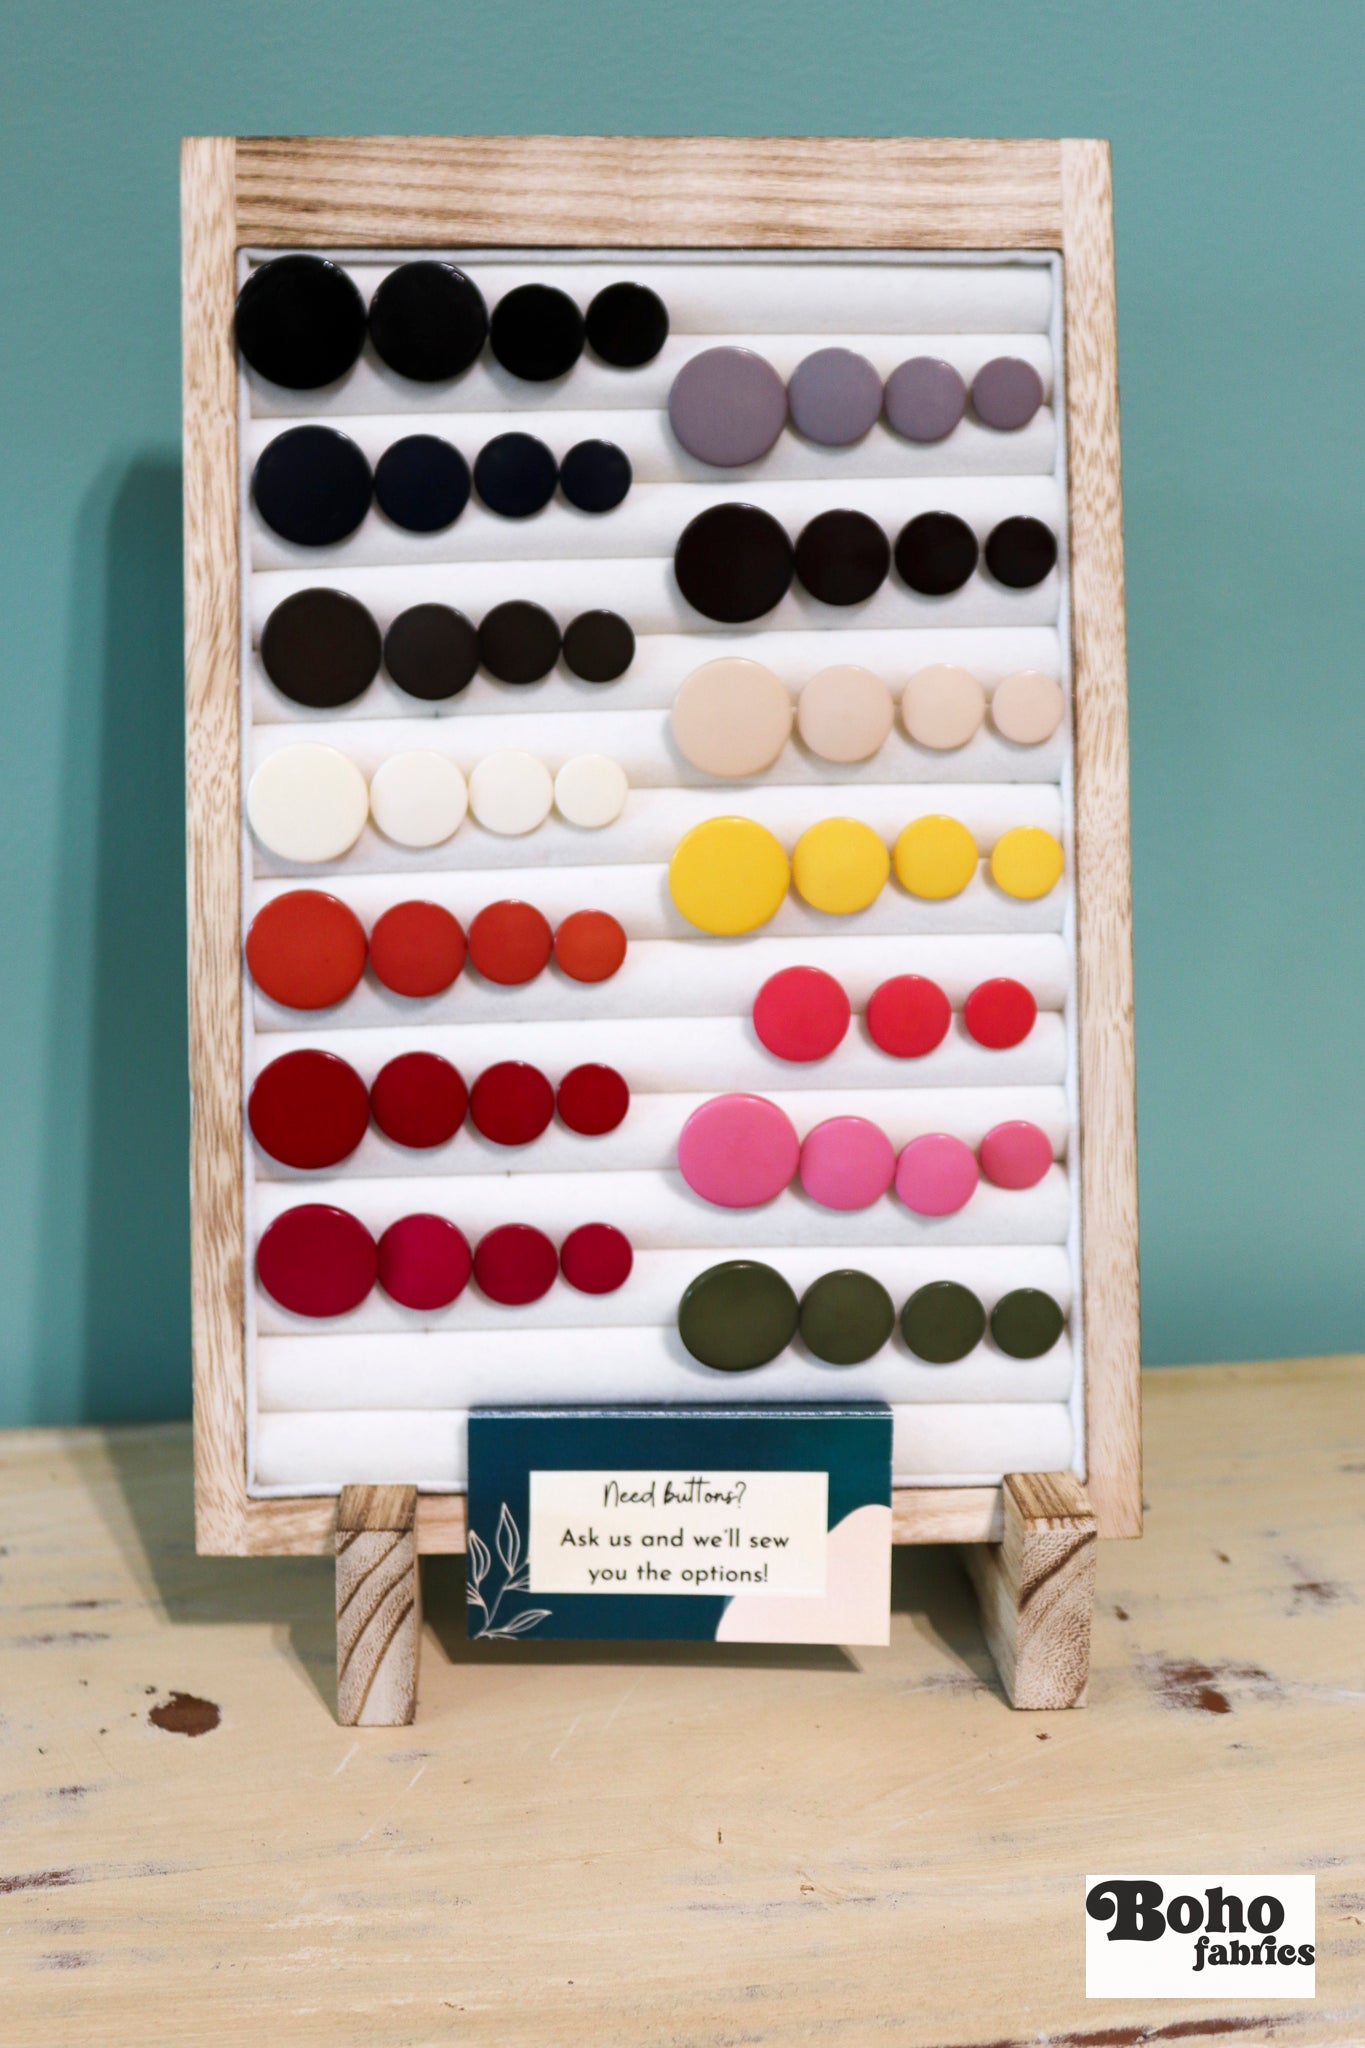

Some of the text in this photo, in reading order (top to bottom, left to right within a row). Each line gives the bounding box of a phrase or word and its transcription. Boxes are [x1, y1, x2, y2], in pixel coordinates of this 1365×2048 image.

[603, 1476, 747, 1508] Need buttons?
[560, 1527, 790, 1549] Ask us and we'll sew
[588, 1561, 769, 1586] you the options!
